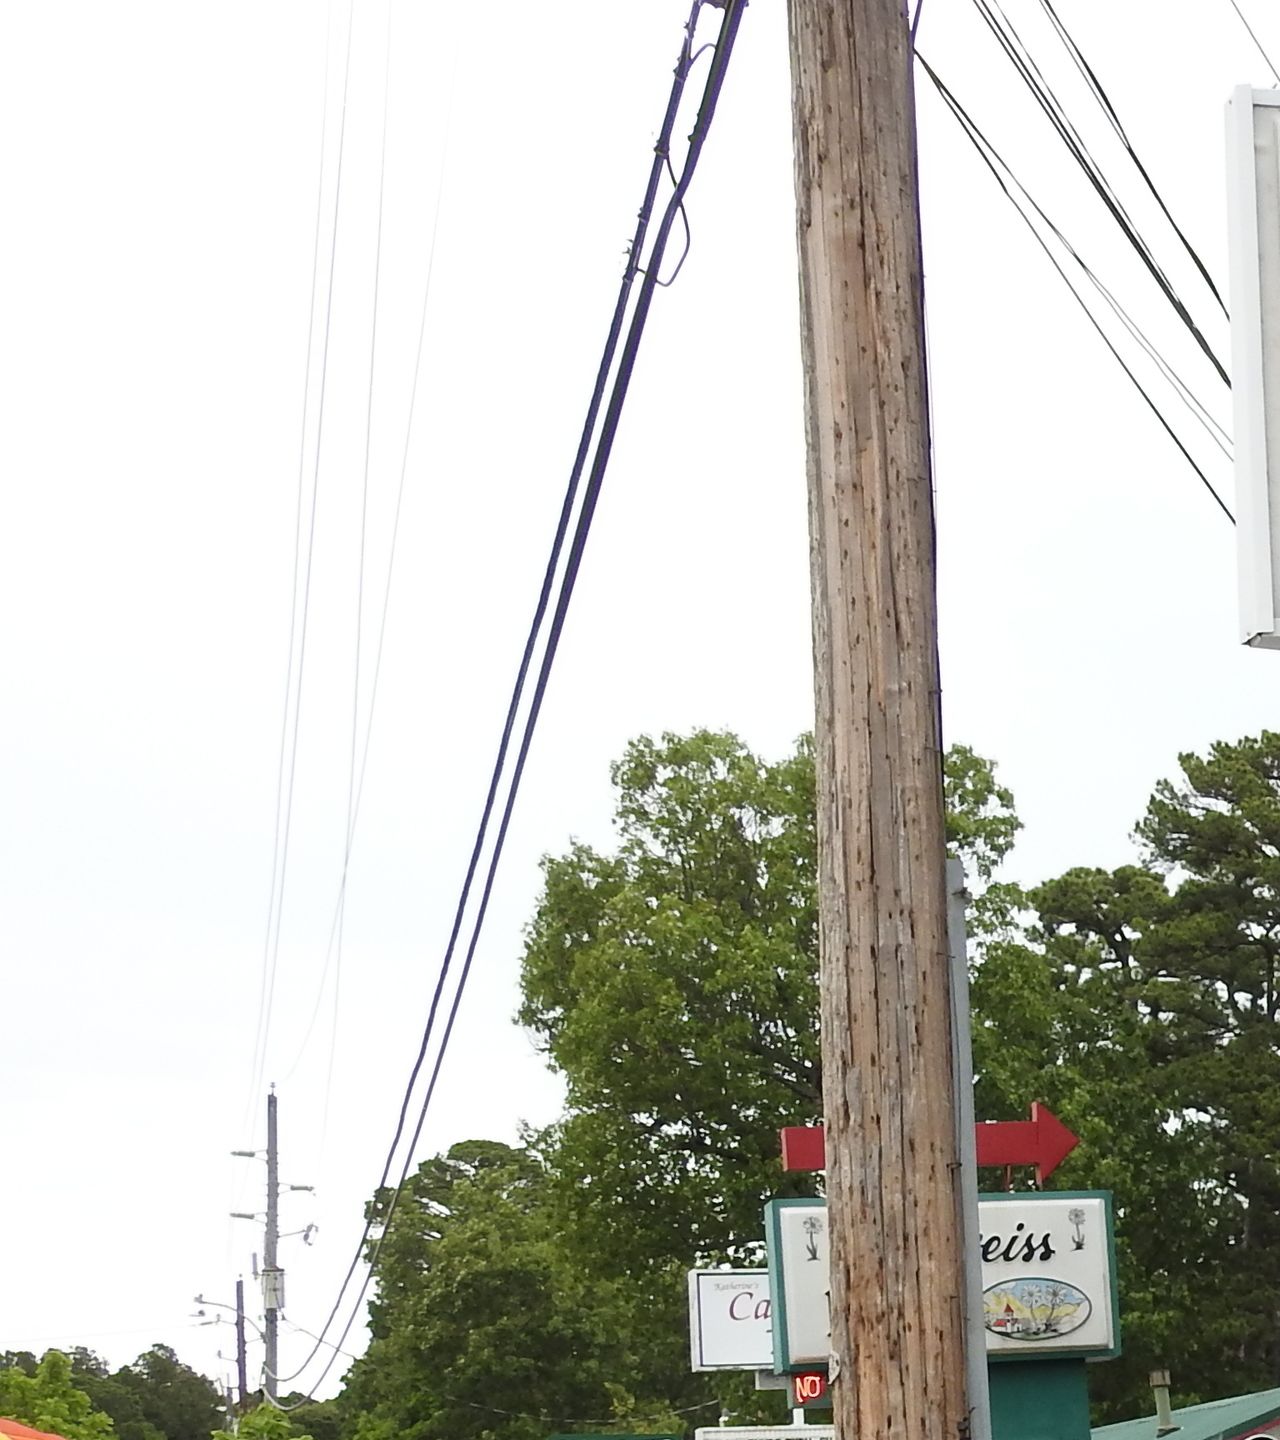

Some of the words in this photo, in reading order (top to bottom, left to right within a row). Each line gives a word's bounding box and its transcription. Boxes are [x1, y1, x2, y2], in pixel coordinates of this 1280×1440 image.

[979, 1222, 1056, 1263] eiss
[729, 1291, 773, 1322] Ca
[795, 1374, 821, 1404] NO
